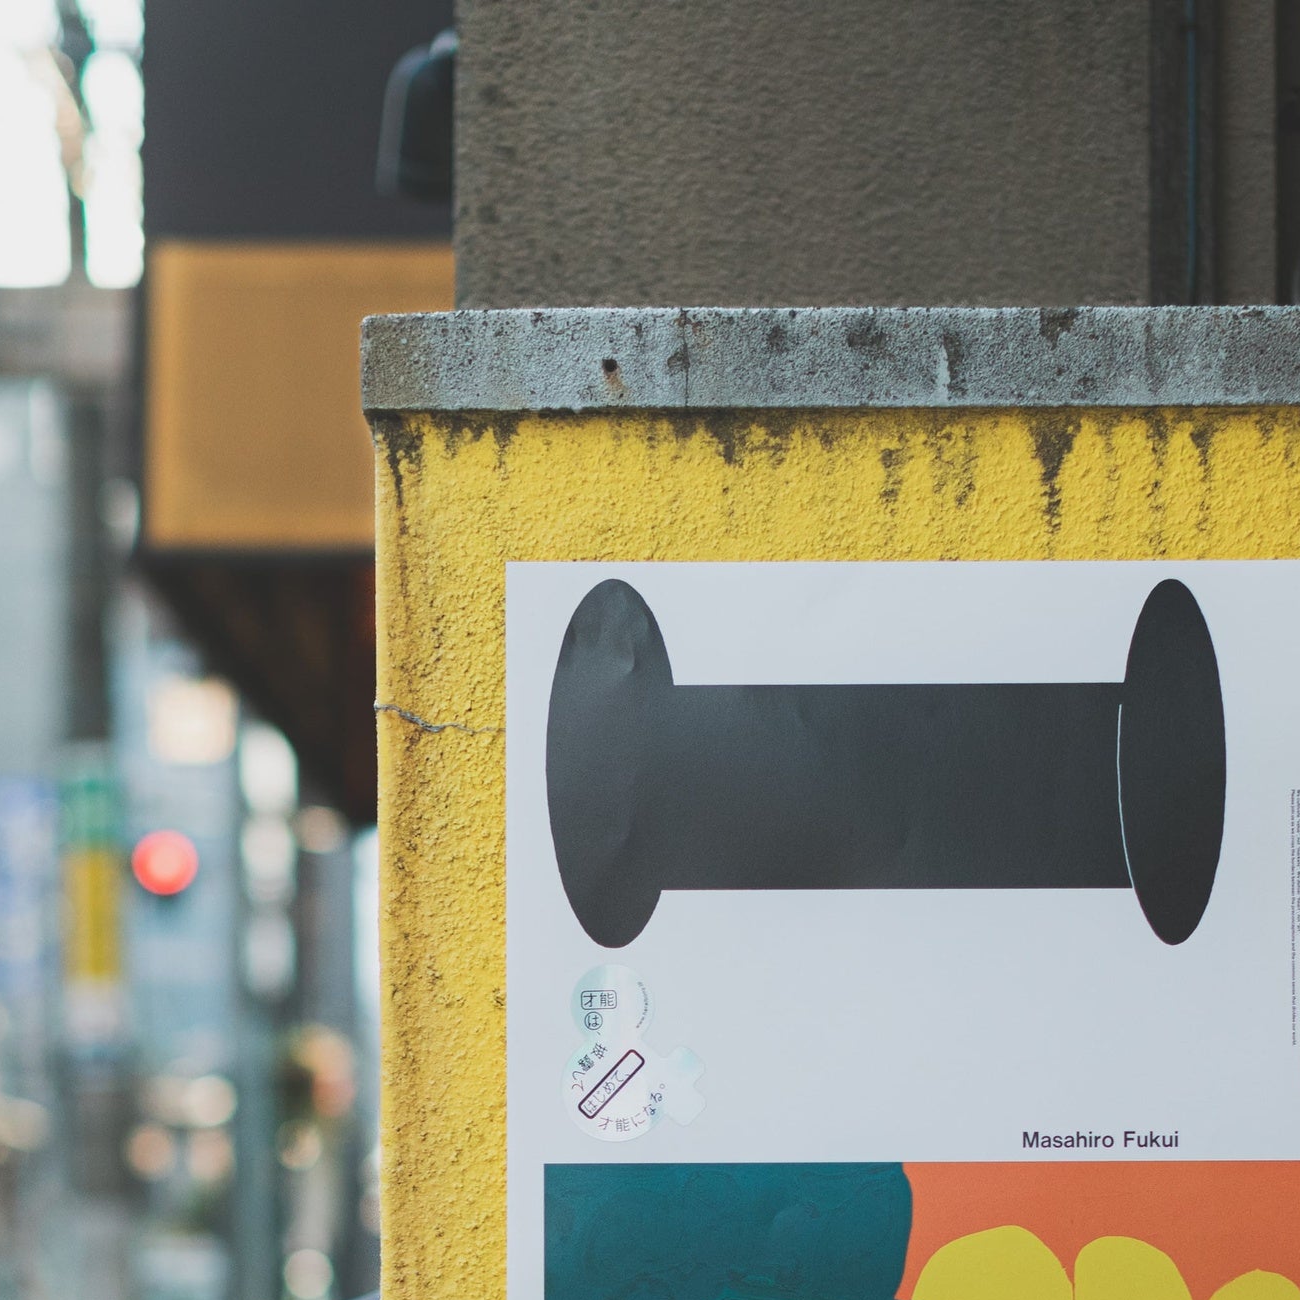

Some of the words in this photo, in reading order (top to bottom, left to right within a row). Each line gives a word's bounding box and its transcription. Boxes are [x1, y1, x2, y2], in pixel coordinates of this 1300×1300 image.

[583, 992, 615, 1008] 才能
[1022, 1131, 1114, 1148] Masahiro
[1124, 1130, 1179, 1148] Fukui
